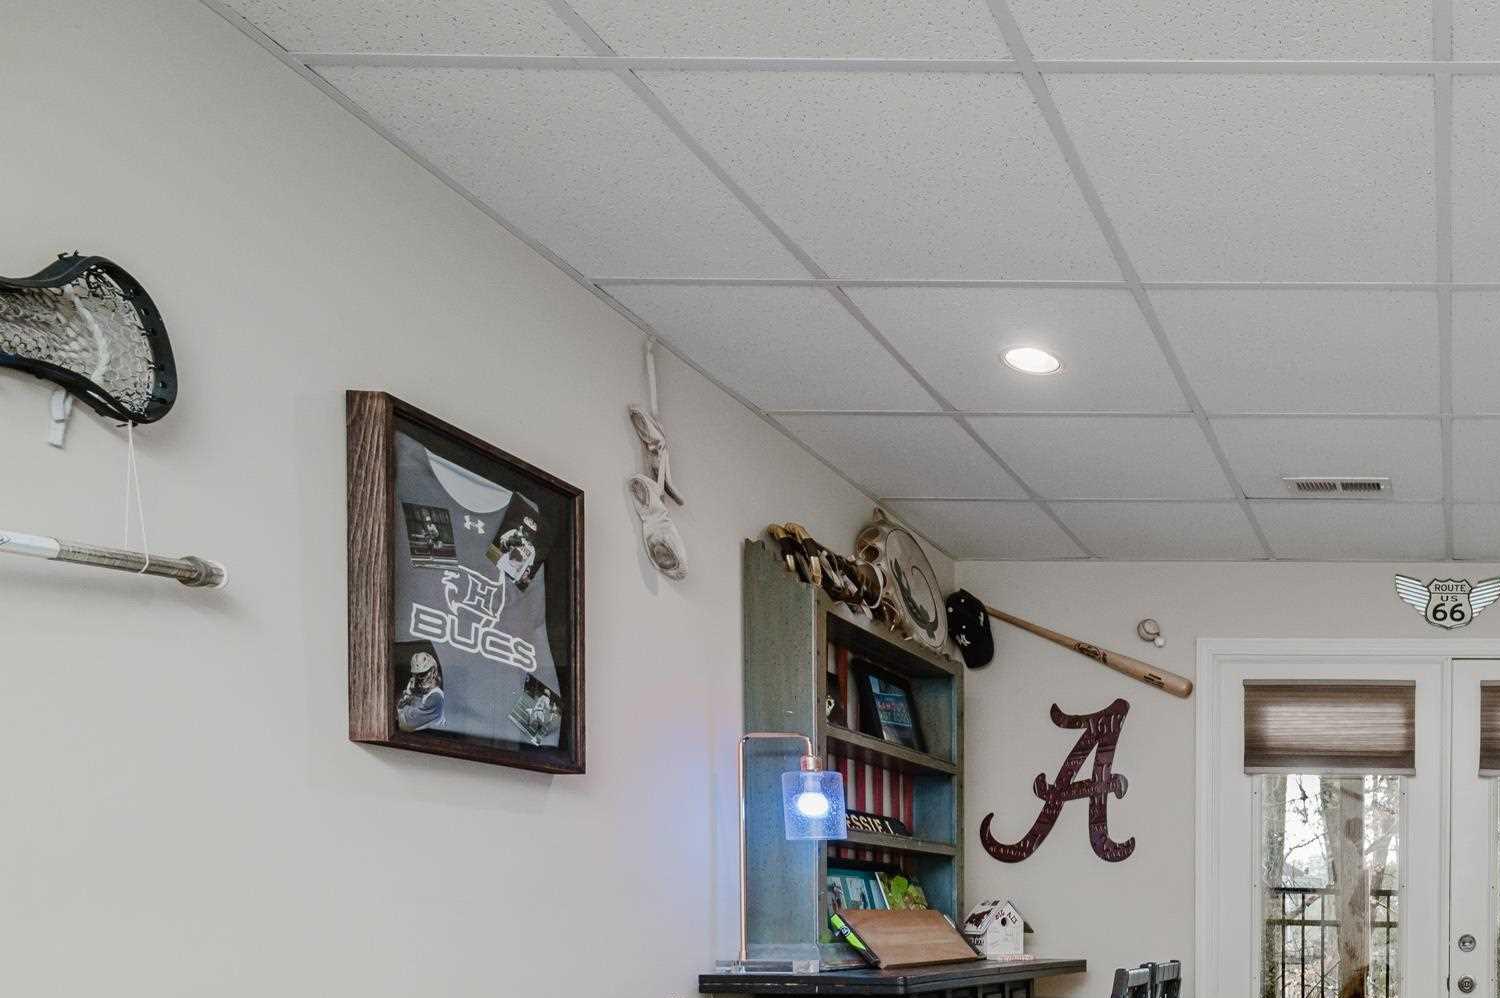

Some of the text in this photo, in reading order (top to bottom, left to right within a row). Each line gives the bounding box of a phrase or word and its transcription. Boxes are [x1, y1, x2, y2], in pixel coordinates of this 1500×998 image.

[1434, 584, 1466, 592] ROUTE
[1432, 603, 1465, 622] 66
[409, 602, 538, 673] BUCS
[979, 698, 1136, 863] A
